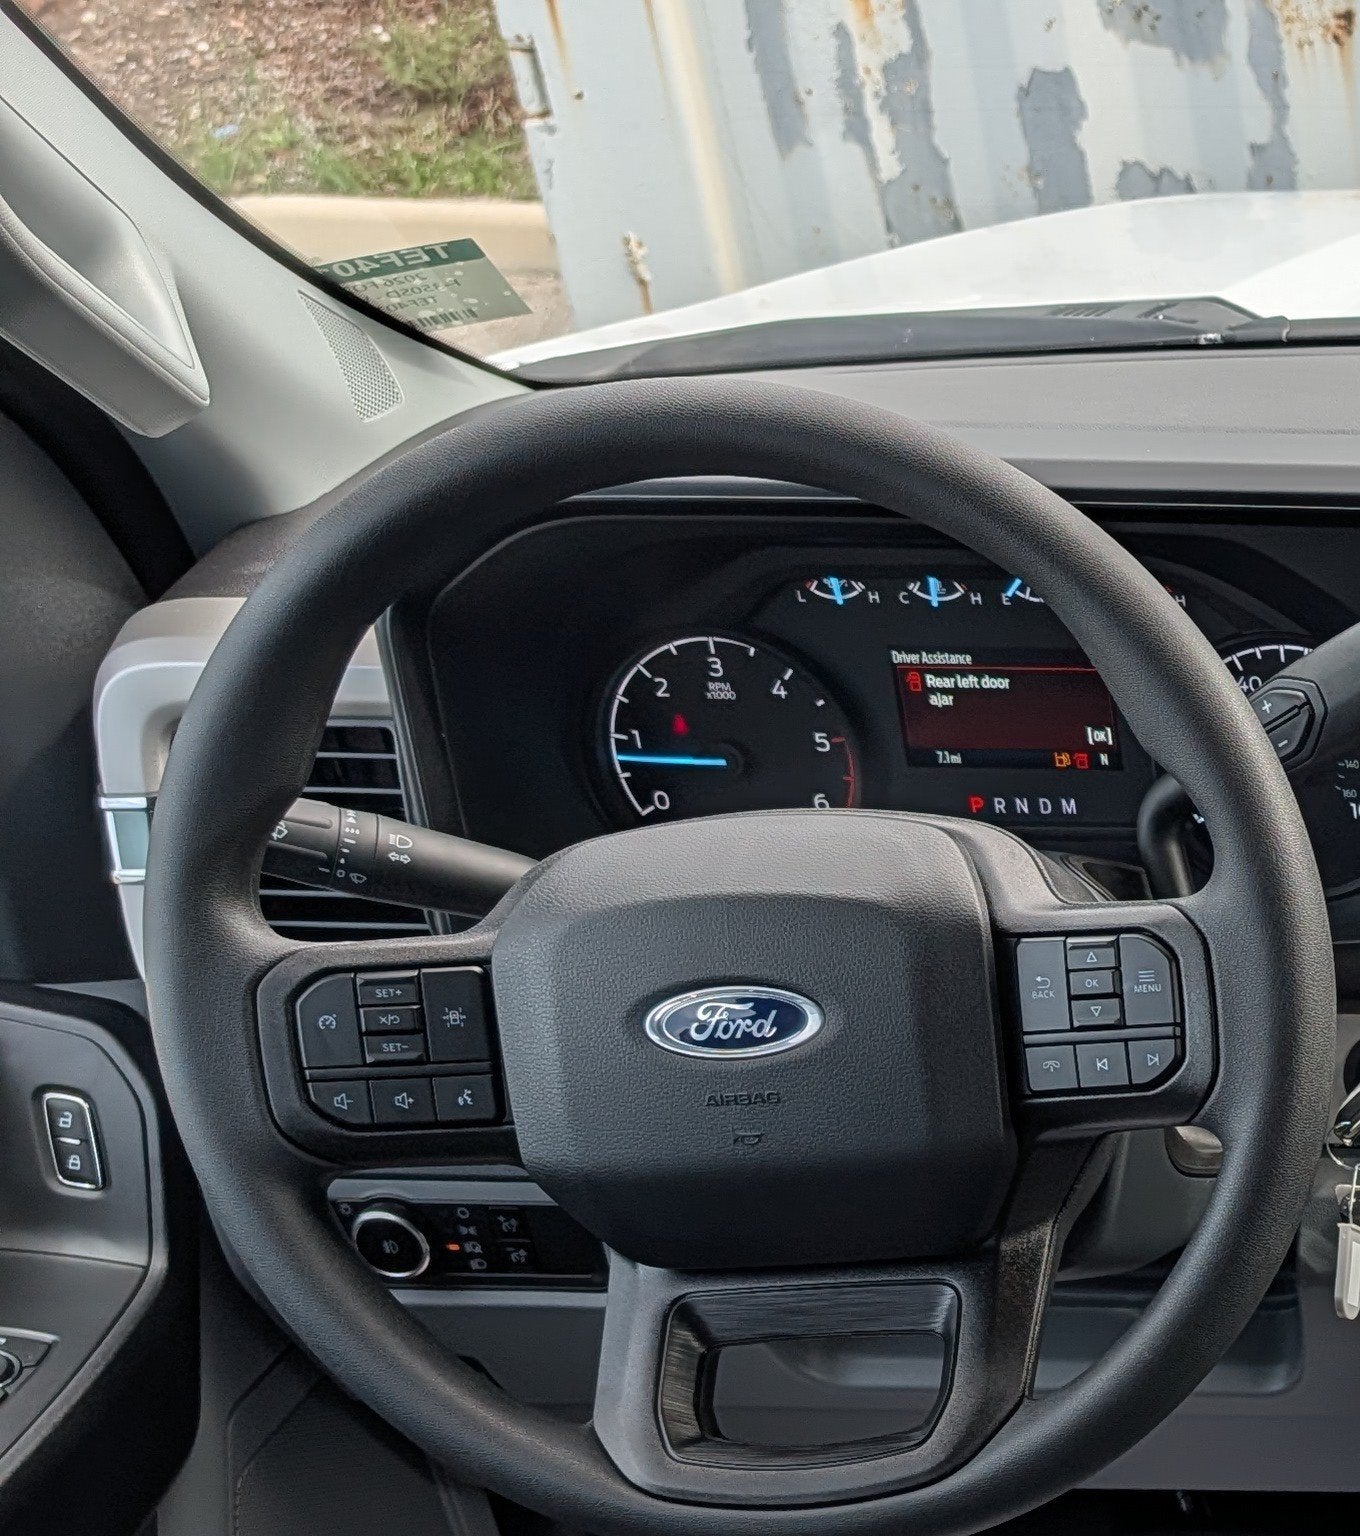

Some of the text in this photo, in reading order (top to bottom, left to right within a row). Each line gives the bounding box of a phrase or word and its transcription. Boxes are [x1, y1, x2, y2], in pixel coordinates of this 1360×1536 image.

[707, 657, 724, 676] 3
[891, 650, 973, 667] Driver Assistance
[654, 677, 670, 698] 2
[707, 681, 732, 692] RPM
[771, 679, 788, 698] 4
[926, 674, 1011, 691] Rear left door
[929, 692, 955, 709] ajar
[814, 732, 831, 752] 5
[653, 790, 671, 811] 0
[969, 797, 1077, 815] P R N D M
[1084, 978, 1099, 988] OK
[1133, 982, 1162, 994] MENU
[1031, 988, 1055, 999] BACK
[689, 1002, 779, 1042] Ford
[704, 1091, 781, 1107] AIRBAG
